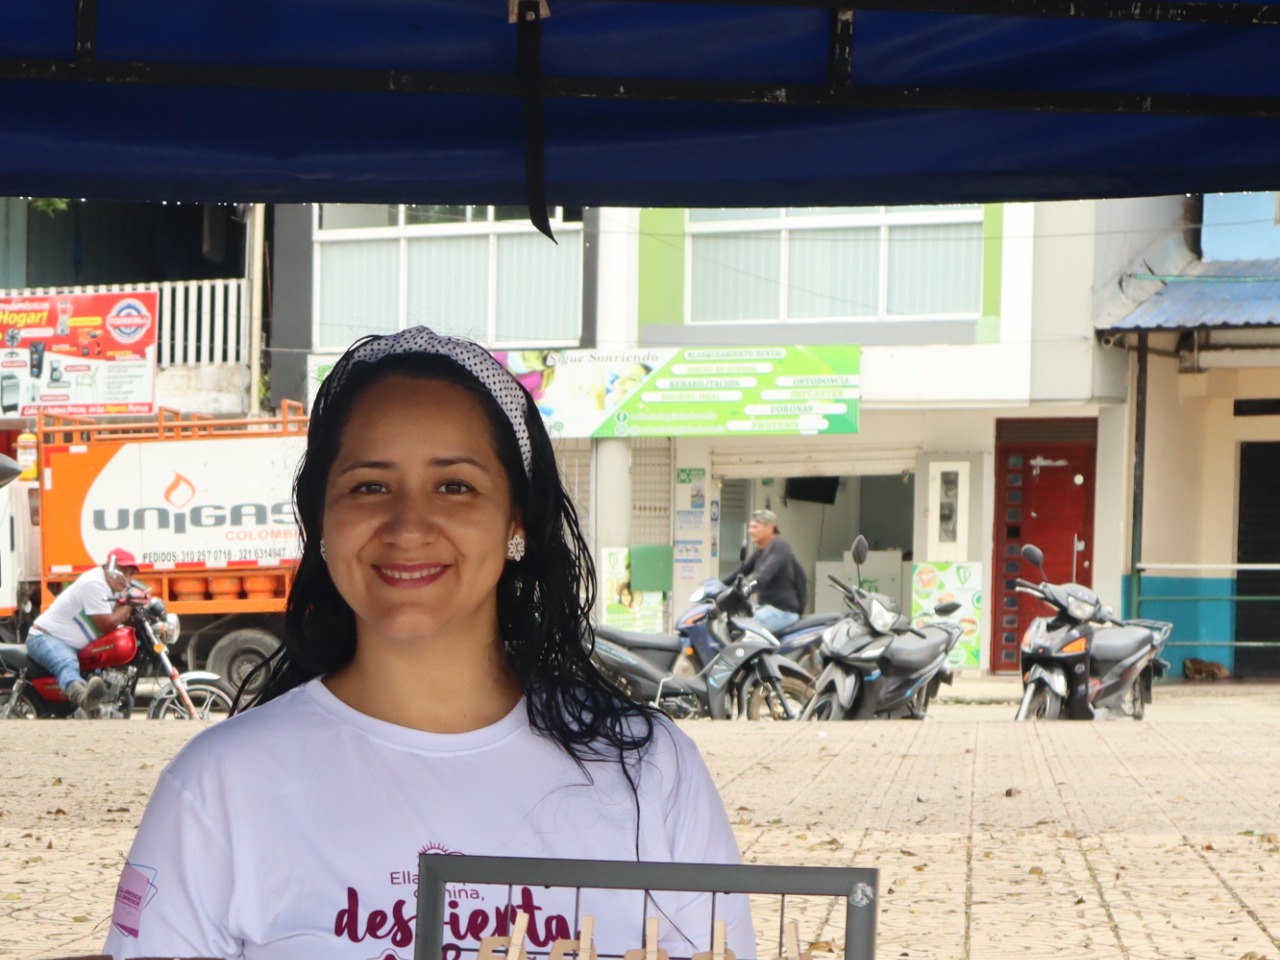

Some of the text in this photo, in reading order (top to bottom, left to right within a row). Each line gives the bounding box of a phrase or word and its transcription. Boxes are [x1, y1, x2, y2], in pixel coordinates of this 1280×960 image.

[548, 351, 660, 365] Sigue Sonriendo
[687, 349, 782, 359] BLANQUEAMIENTO DENTAL
[770, 404, 814, 413] CORONAS
[143, 551, 178, 562] PEDIDOS:
[181, 551, 195, 561] 310
[197, 550, 212, 561] 257
[213, 550, 232, 560] 0718
[239, 549, 252, 559] 321
[254, 547, 287, 559] 6314947
[334, 887, 571, 948] desierta
